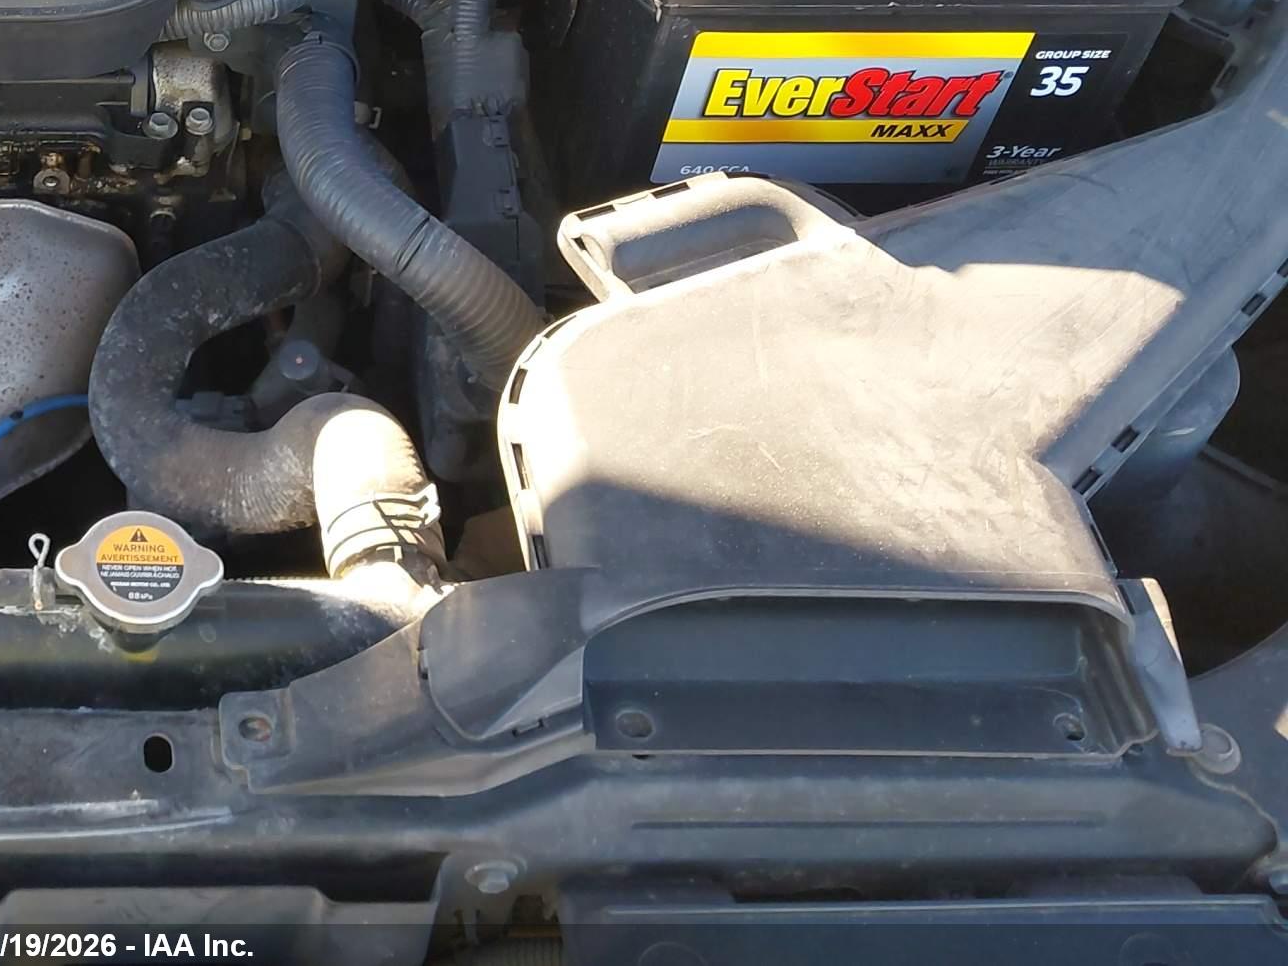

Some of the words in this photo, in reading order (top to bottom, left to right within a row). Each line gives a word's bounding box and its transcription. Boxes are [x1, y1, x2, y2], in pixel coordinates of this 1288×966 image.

[1035, 50, 1082, 59] GROUP
[1081, 50, 1111, 59] SIZE
[1030, 66, 1090, 96] 35
[702, 67, 1005, 118] EverStart
[870, 124, 955, 139] MAXX
[986, 145, 1062, 158] 3-Year
[679, 165, 714, 175] 640
[113, 544, 165, 553] WARNING
[100, 554, 179, 563] AVERTISSEMENT
